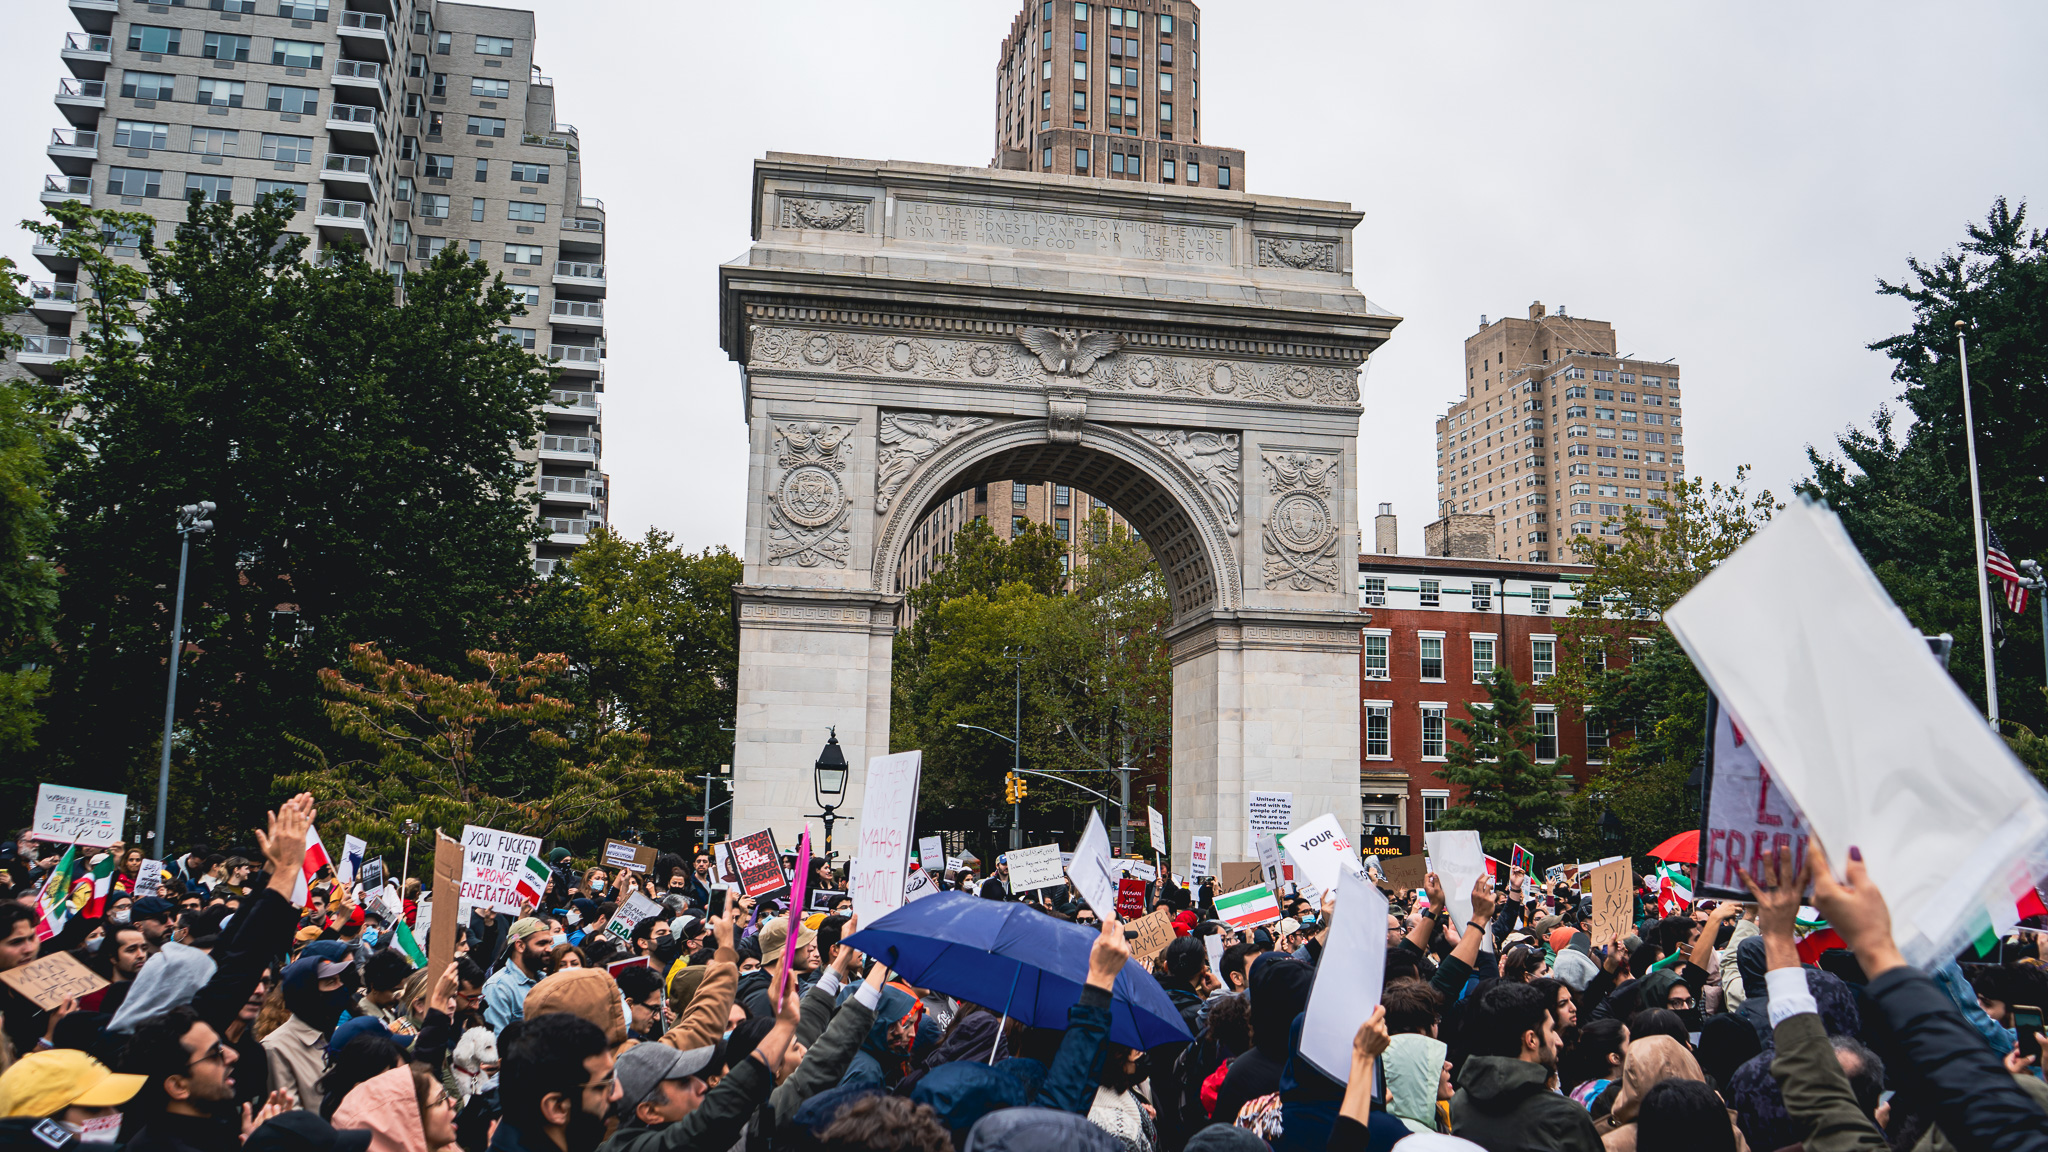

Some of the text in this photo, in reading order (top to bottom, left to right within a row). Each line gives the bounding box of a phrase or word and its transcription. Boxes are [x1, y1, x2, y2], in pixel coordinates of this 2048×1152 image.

[906, 203, 1223, 241] LET US RAISE A STANDARD TO WHICH THE WISE
[905, 215, 1224, 251] AND THE HONEST CAN REPAIR THE EVENT
[905, 226, 1076, 250] IS IN THE HAND OF GOD
[1132, 245, 1224, 262] WASHINGTON
[46, 793, 110, 808] WOMEN LIFE
[55, 803, 108, 818] FREEDOM
[869, 788, 903, 820] NAME
[97, 827, 116, 840] زن
[468, 831, 537, 856] YOU FUCKED
[861, 827, 903, 859] MAHSA
[1300, 830, 1334, 852] YOUR
[1374, 836, 1390, 846] NO
[617, 845, 635, 853] SOLUTION
[735, 844, 750, 856] BE
[1332, 837, 1353, 852] SIL
[1362, 847, 1403, 856] ALCOHOL
[470, 851, 522, 873] WITH THE
[737, 850, 760, 864] OUR
[740, 855, 770, 871] VOICE
[476, 866, 514, 887] WRONG
[1134, 866, 1150, 874] WOMAN
[1604, 865, 1625, 894] زن
[460, 882, 523, 908] ENERATION
[857, 867, 898, 908] AMINI
[625, 902, 647, 917] ISLAMIC
[609, 920, 632, 941] IRA
[1135, 911, 1168, 937] HER
[6, 954, 75, 985] WOMAN
[33, 969, 77, 992] LIFE
[34, 973, 98, 1009] FREEDOM
